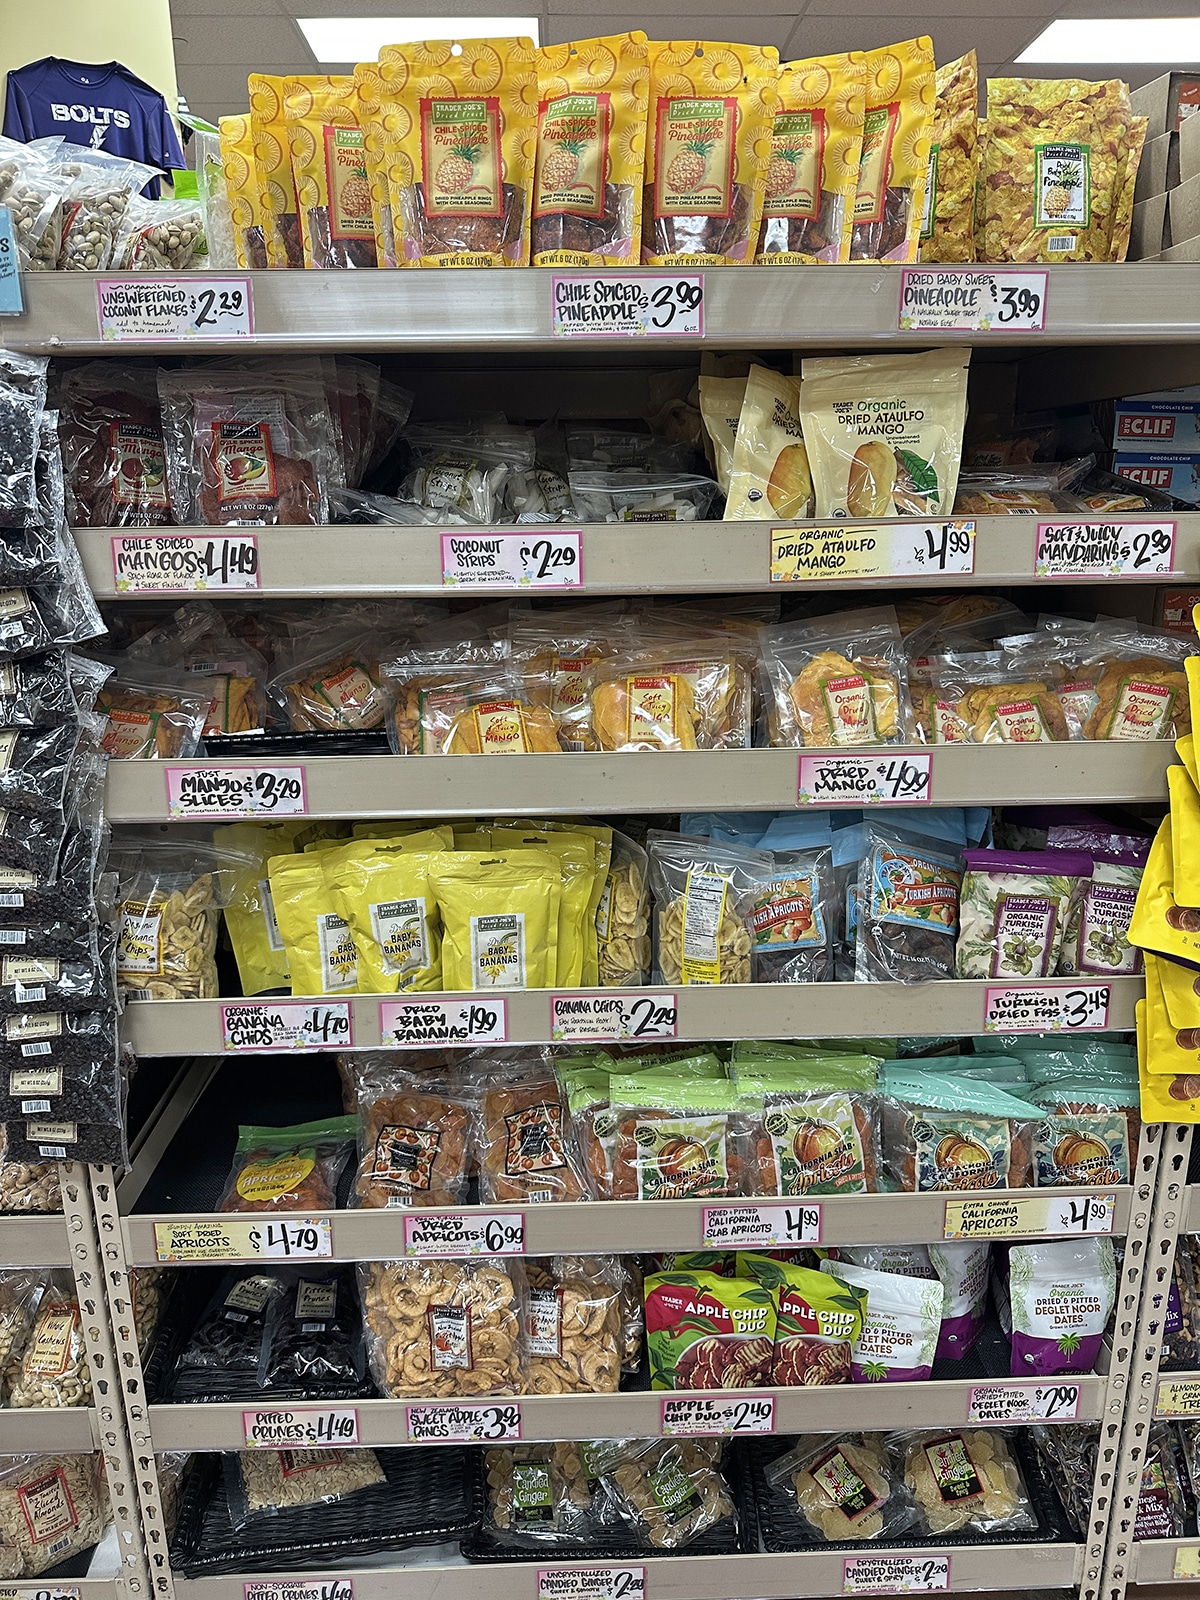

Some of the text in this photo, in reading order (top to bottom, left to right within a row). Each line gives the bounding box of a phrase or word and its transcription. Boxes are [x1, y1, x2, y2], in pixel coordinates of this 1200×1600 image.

[50, 103, 131, 129] BOLTS
[434, 126, 458, 134] CHILE
[543, 128, 597, 142] Pineapple
[668, 130, 724, 143] Pineapple
[434, 133, 489, 147] Pineapple
[908, 274, 995, 285] DRIED BABY SWEET
[102, 289, 186, 304] UNSWEETENED
[556, 280, 641, 304] CHILE SPICED
[904, 287, 981, 307] PINEAPPLE
[103, 304, 188, 318] COCONUT FLAKES
[557, 303, 637, 321] PINEAPPLE
[857, 399, 907, 412] Organic
[838, 411, 924, 425] DRIED ATAULFO
[857, 424, 905, 436] MANGO
[1130, 418, 1173, 434] CLIF
[121, 444, 162, 457] Mango
[140, 440, 163, 448] SPICED
[223, 445, 264, 455] Mango
[799, 530, 845, 541] ORGANIC
[1045, 525, 1122, 544] SOFT JUICY
[122, 537, 193, 550] CHILE SPICED
[451, 538, 504, 554] COCONUT
[777, 539, 876, 559] DRIED ATAULFO
[1038, 541, 1119, 562] MANDARINS
[118, 551, 199, 573] MANGOS
[457, 554, 496, 568] STRIPS
[797, 555, 846, 571] MANGO
[643, 693, 662, 701] Soft
[834, 693, 866, 705] Organic
[1128, 694, 1162, 708] Organic
[843, 705, 864, 714] Dried
[1130, 705, 1153, 717] Dried
[1005, 717, 1036, 727] Organic
[485, 732, 520, 743] MANGO
[1014, 727, 1035, 736] Dried
[816, 767, 869, 781] DRIED
[181, 777, 243, 793] MANGO
[815, 779, 876, 793] MANGO
[180, 792, 243, 807] SLICES
[913, 858, 942, 874] ORGANIC
[905, 887, 931, 900] TURKISH
[1094, 886, 1116, 894] TRADER
[1006, 913, 1044, 922] ORGANIC
[1005, 920, 1043, 930] TURKISH
[391, 932, 412, 943] BABY
[125, 943, 148, 955] Chips
[384, 939, 422, 955] BANANAS
[488, 946, 509, 955] BABY
[480, 955, 518, 967] BANANAS
[1005, 990, 1044, 998] Organic
[402, 1004, 440, 1015] DRIED
[555, 1000, 624, 1015] BANANA CHIPS
[993, 998, 1059, 1008] TURKISH
[225, 1007, 264, 1016] ORGANIC
[990, 1008, 1060, 1020] DRIED FIGS
[226, 1014, 284, 1030] BANANA
[397, 1014, 446, 1027] BABY
[231, 1030, 273, 1046] CHIPS
[393, 1026, 469, 1041] BANANAS
[787, 1152, 835, 1176] CALIFORNIA
[963, 1200, 1010, 1210] EXTRA CHOICE
[708, 1209, 728, 1217] DRIED
[961, 1206, 1018, 1220] CALIFORNIA
[420, 1220, 463, 1231] DRIED
[708, 1215, 760, 1228] CALIFORNIA
[960, 1216, 1018, 1232] APRICOTS
[412, 1229, 480, 1244] APRICOTS
[706, 1223, 772, 1238] SLAB APRICOTS
[170, 1236, 230, 1249] APRICOTS
[1049, 1288, 1085, 1299] Organic
[1037, 1296, 1099, 1305] DRIED PITTED
[685, 1302, 768, 1320] APPLE CHIP
[1035, 1304, 1101, 1316] DEGLET NOOR
[818, 1311, 855, 1324] CHIP
[1054, 1315, 1083, 1325] DATES
[738, 1321, 765, 1333] DUO
[823, 1324, 853, 1337] DUO
[881, 1337, 913, 1346] NOOR
[860, 1343, 893, 1354] DATES
[974, 1387, 1004, 1395] ORGANIC
[666, 1401, 715, 1412] APPLE
[972, 1399, 1029, 1410] DEGLET NOOR
[256, 1412, 294, 1425] PITTED
[410, 1411, 483, 1425] SWEET APPLE
[664, 1411, 721, 1423] CHIP DUO
[978, 1410, 1012, 1420] DATES
[252, 1423, 305, 1441] PRUNES
[413, 1425, 448, 1438] RINGS
[516, 1477, 549, 1489] Candied
[518, 1490, 548, 1505] Ginger
[34, 1500, 65, 1521] Almonds
[1146, 1502, 1164, 1512] Mix
[856, 1558, 912, 1566] CRYSTALLIZED
[547, 1570, 611, 1578] UNCRYSTALLIZED
[846, 1565, 921, 1577] CANDIED GINGER
[540, 1577, 613, 1590] CANDIED GINGER
[247, 1590, 279, 1600] PITTED
